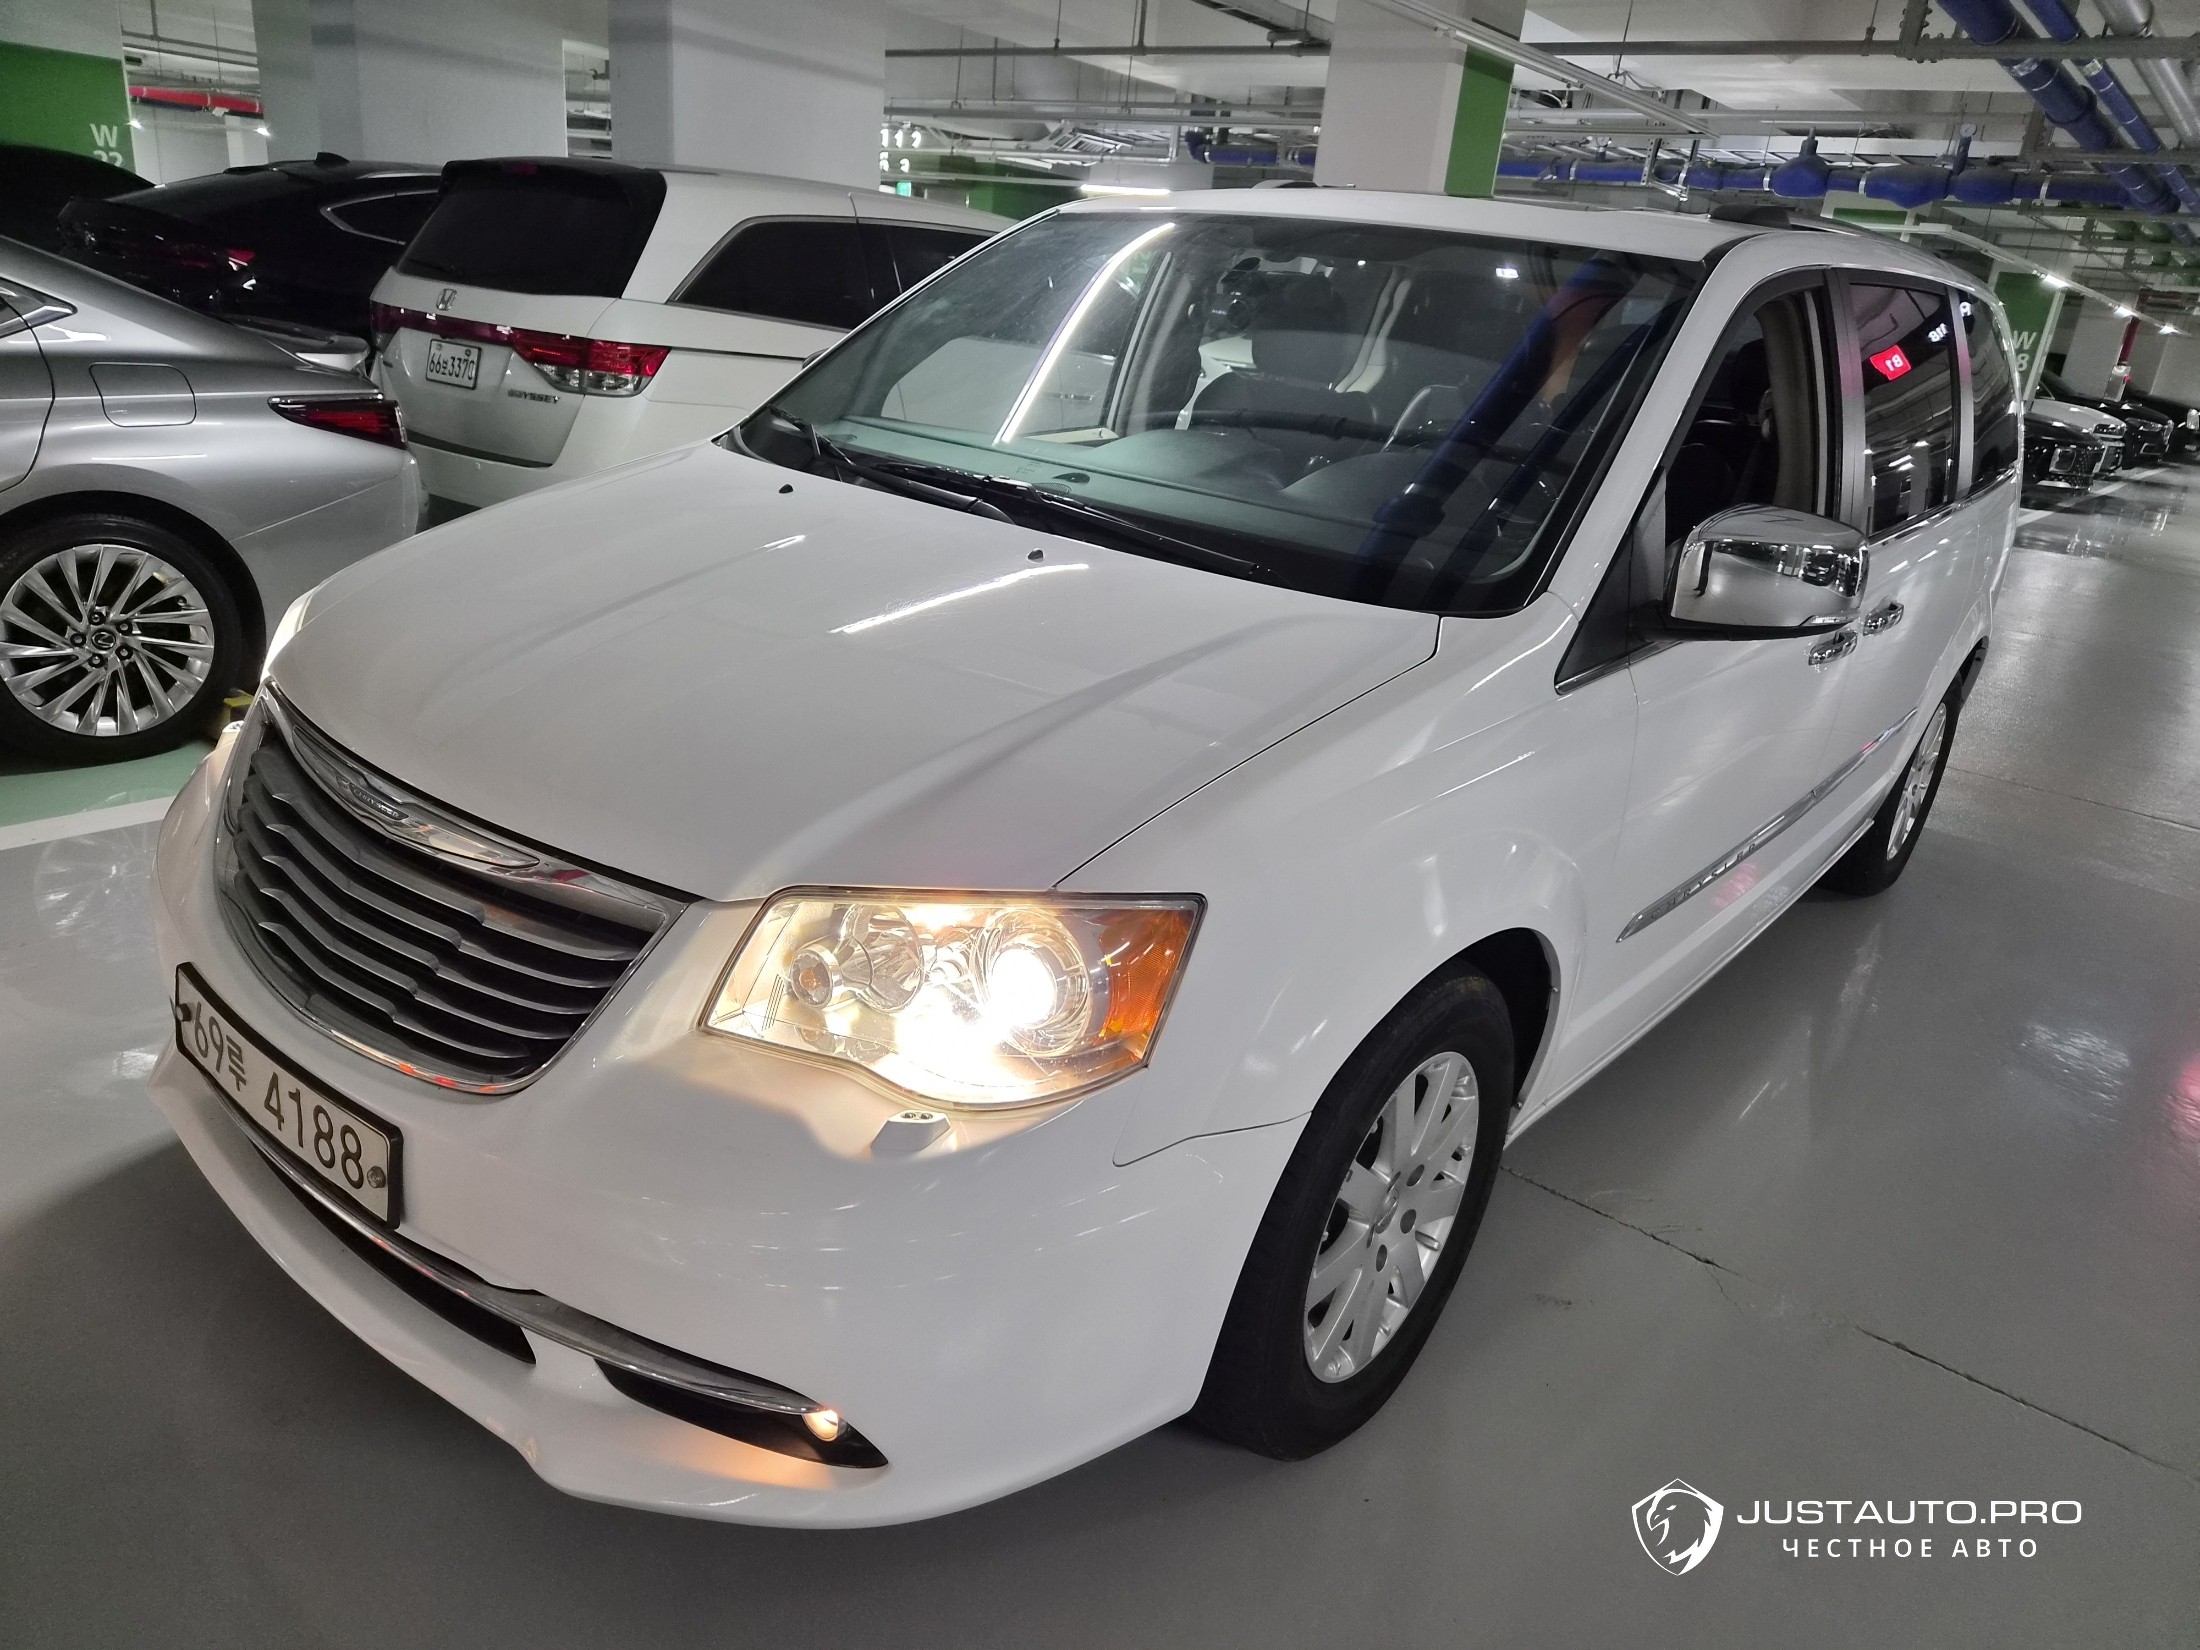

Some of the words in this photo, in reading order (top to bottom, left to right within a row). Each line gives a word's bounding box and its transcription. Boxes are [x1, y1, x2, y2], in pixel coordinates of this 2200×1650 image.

[90, 123, 118, 147] W
[2012, 331, 2036, 350] W
[194, 1001, 246, 1092] 69루
[264, 1071, 364, 1189] 4188
